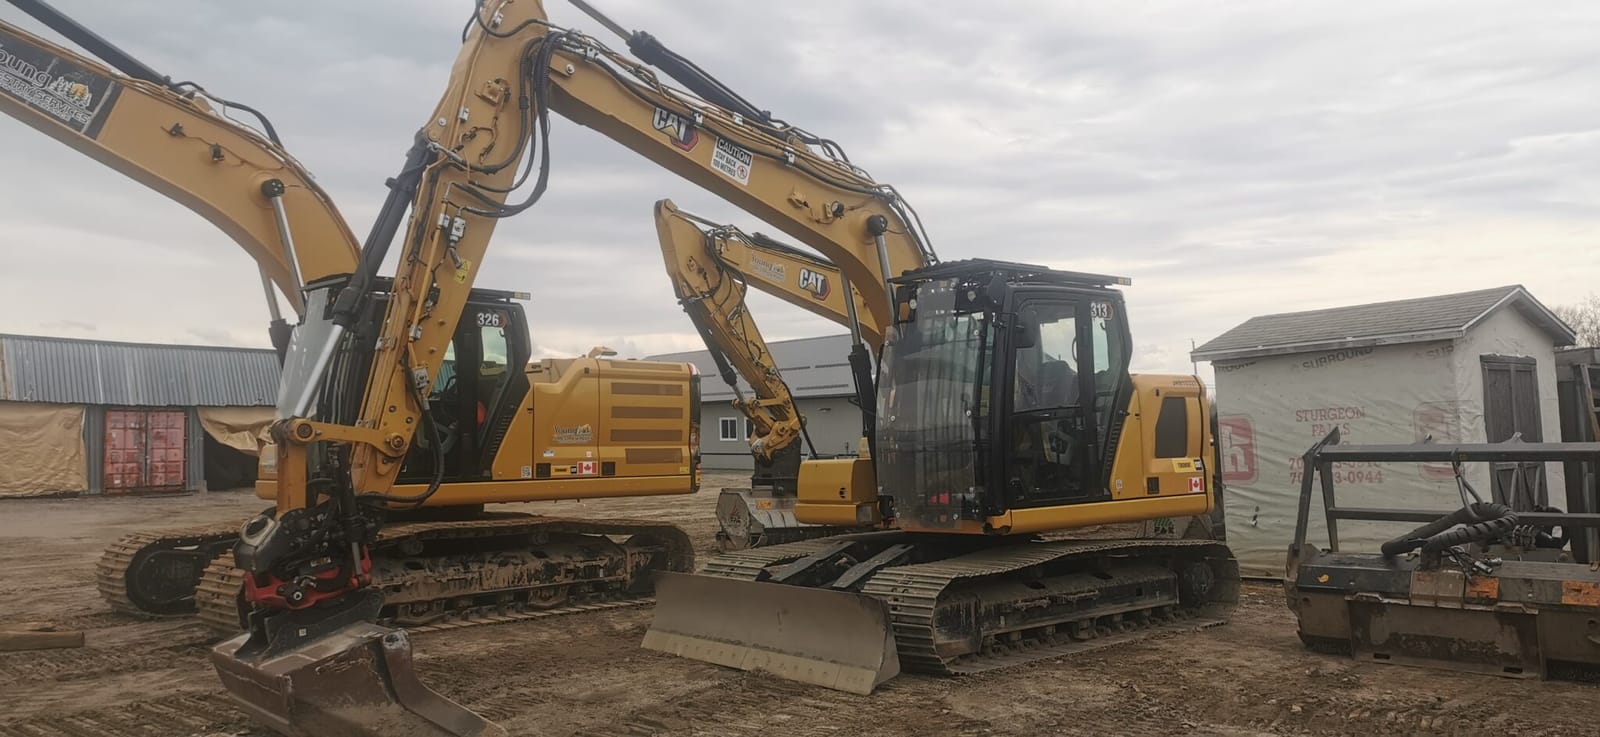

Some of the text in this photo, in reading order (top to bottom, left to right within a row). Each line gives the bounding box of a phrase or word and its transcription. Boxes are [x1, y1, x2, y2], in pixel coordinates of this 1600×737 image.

[653, 107, 689, 142] CAT
[718, 139, 751, 166] CAUTION
[800, 268, 825, 294] CAT
[477, 312, 499, 326] 326
[1090, 302, 1107, 318] 313
[1302, 345, 1374, 371] SURROUND
[1296, 406, 1365, 422] STURGEON
[1311, 422, 1350, 437] FAS
